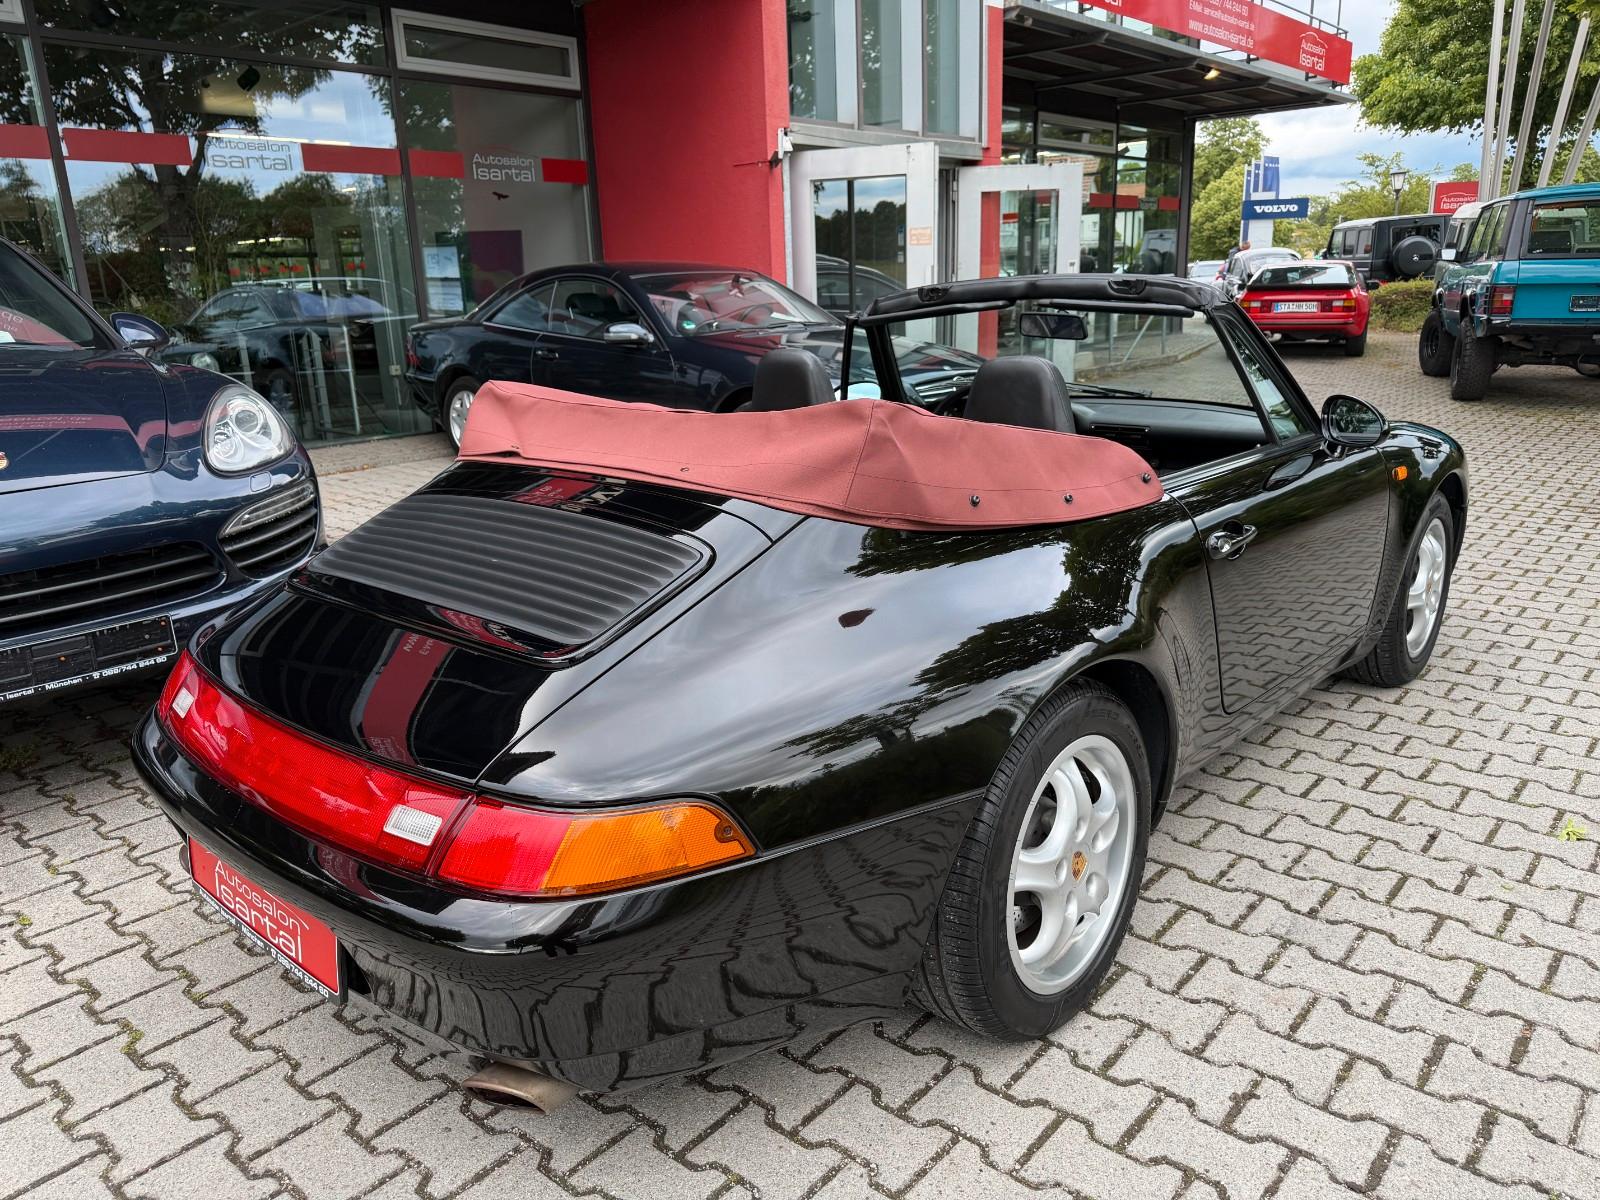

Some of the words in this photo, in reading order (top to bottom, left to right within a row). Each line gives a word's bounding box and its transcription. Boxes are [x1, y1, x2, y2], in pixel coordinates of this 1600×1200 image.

[1188, 19, 1254, 49] www.autosalon-isartal.de
[1301, 39, 1325, 56] Autosalon
[1300, 48, 1325, 71] Isartal
[207, 137, 291, 153] Autosalon
[205, 153, 293, 171] Isartal
[472, 153, 534, 167] Autosalon
[472, 163, 536, 182] Isartal
[1253, 204, 1299, 213] VOLVO
[45, 678, 83, 691] München
[215, 860, 301, 936] Autosalon
[214, 872, 303, 963] Isartal
